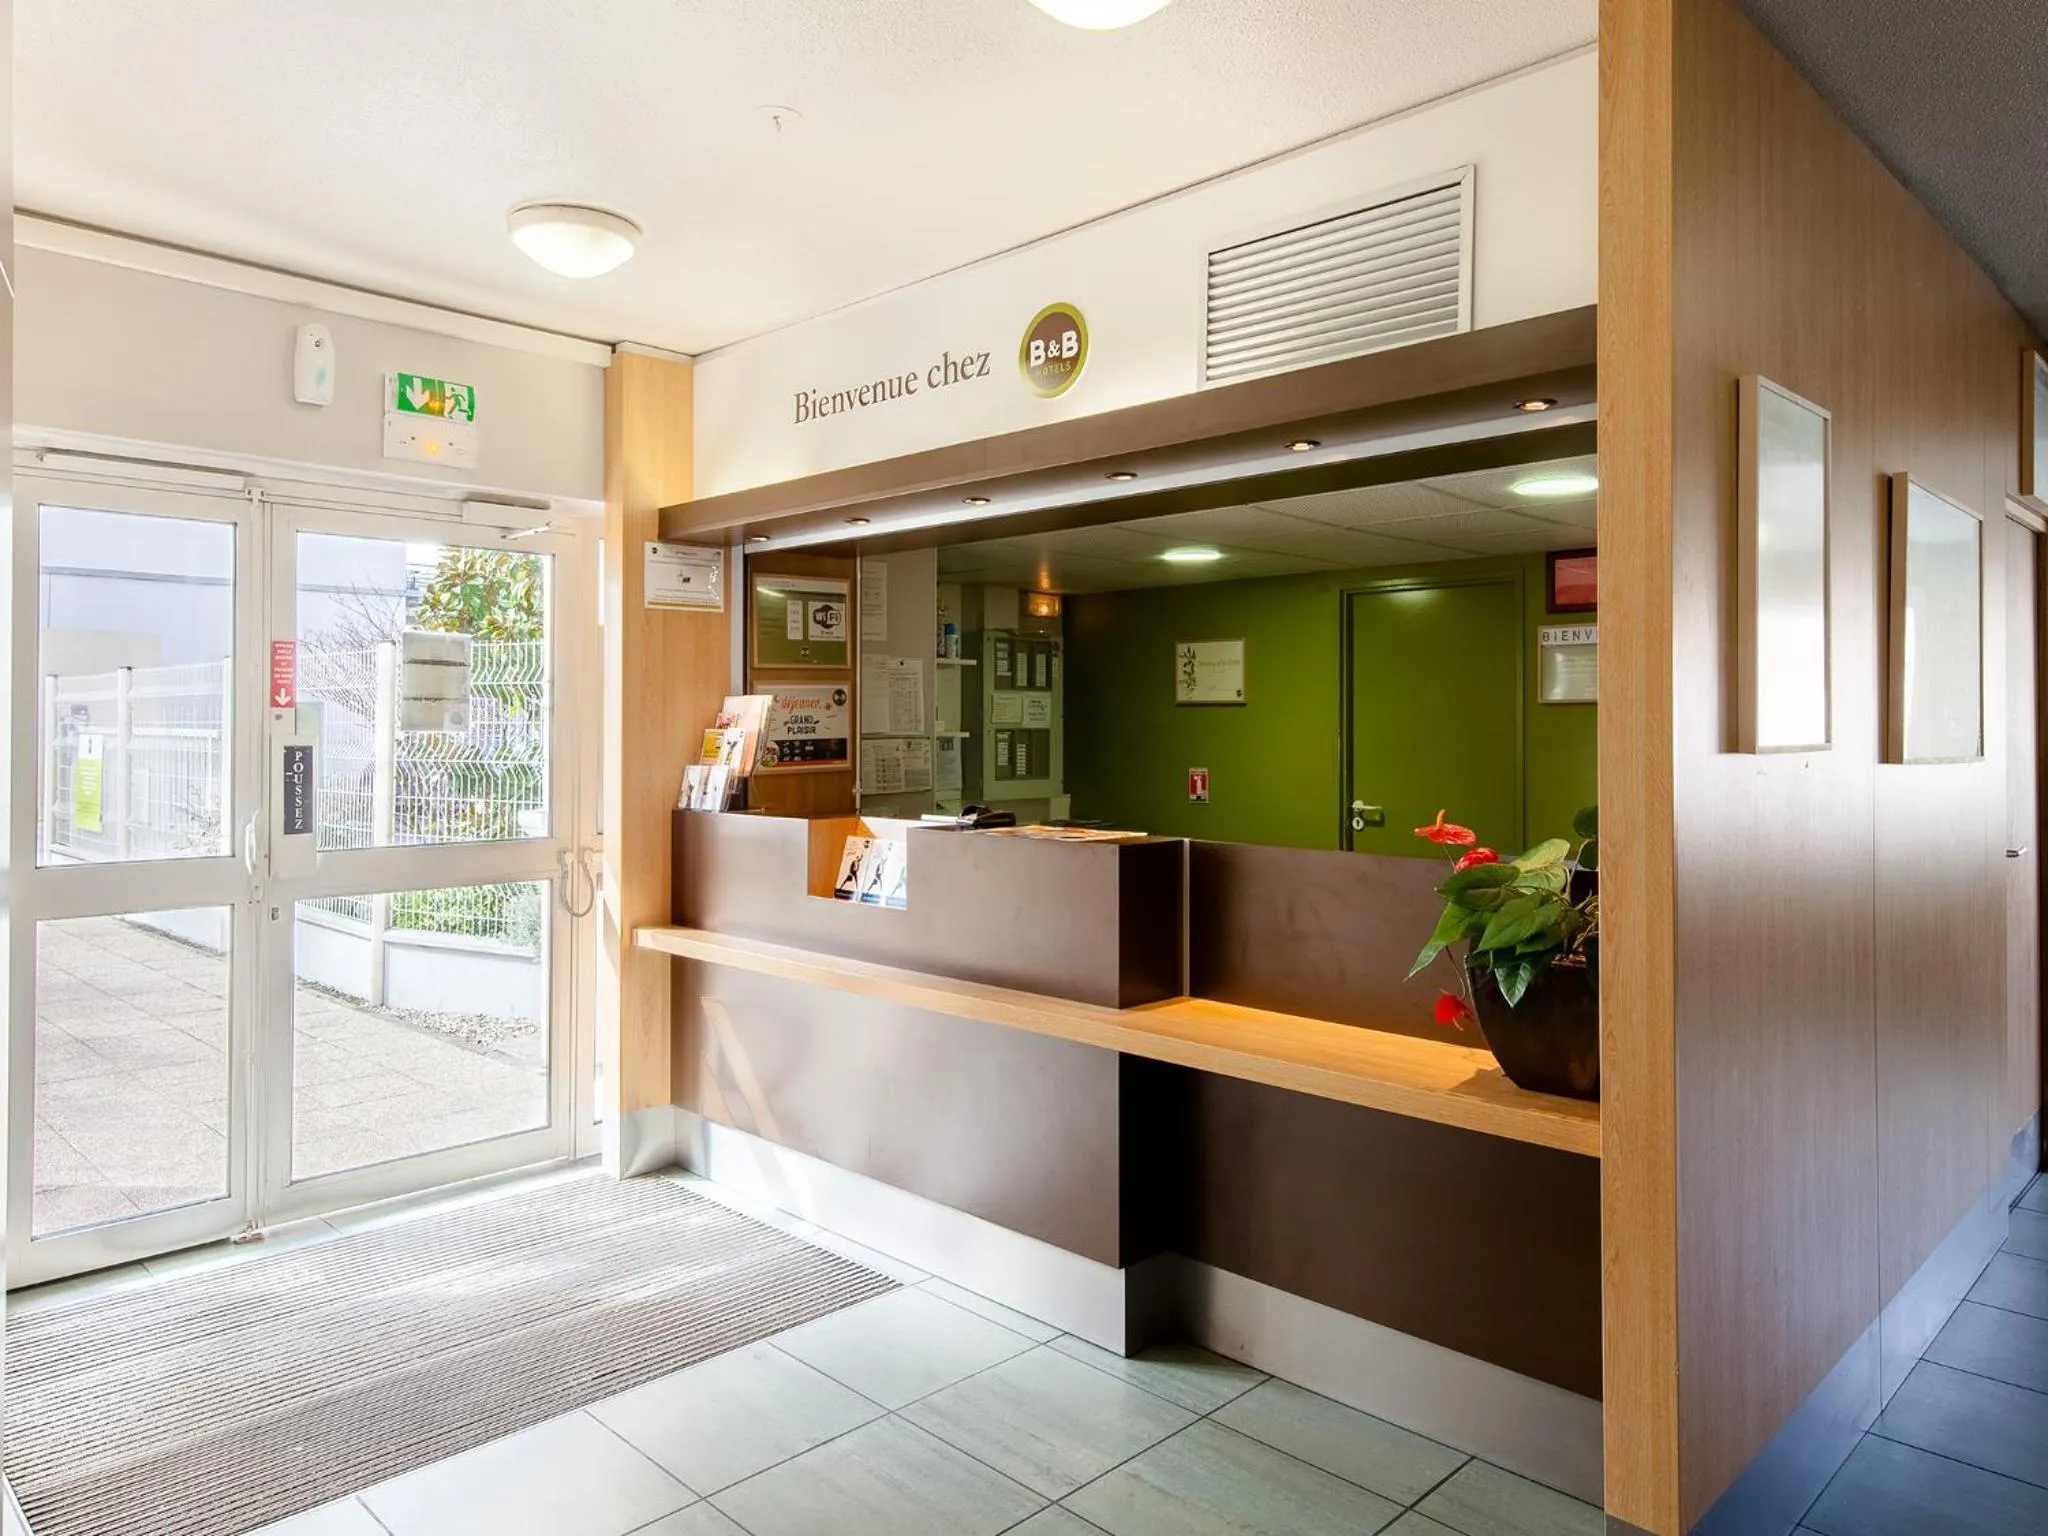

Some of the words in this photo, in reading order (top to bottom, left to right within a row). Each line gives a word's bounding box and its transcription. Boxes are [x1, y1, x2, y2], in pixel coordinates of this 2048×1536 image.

[1030, 330, 1078, 369] B&B
[793, 371, 917, 425] Bienvenue
[927, 351, 991, 390] chez
[293, 750, 304, 830] POUSSEZ
